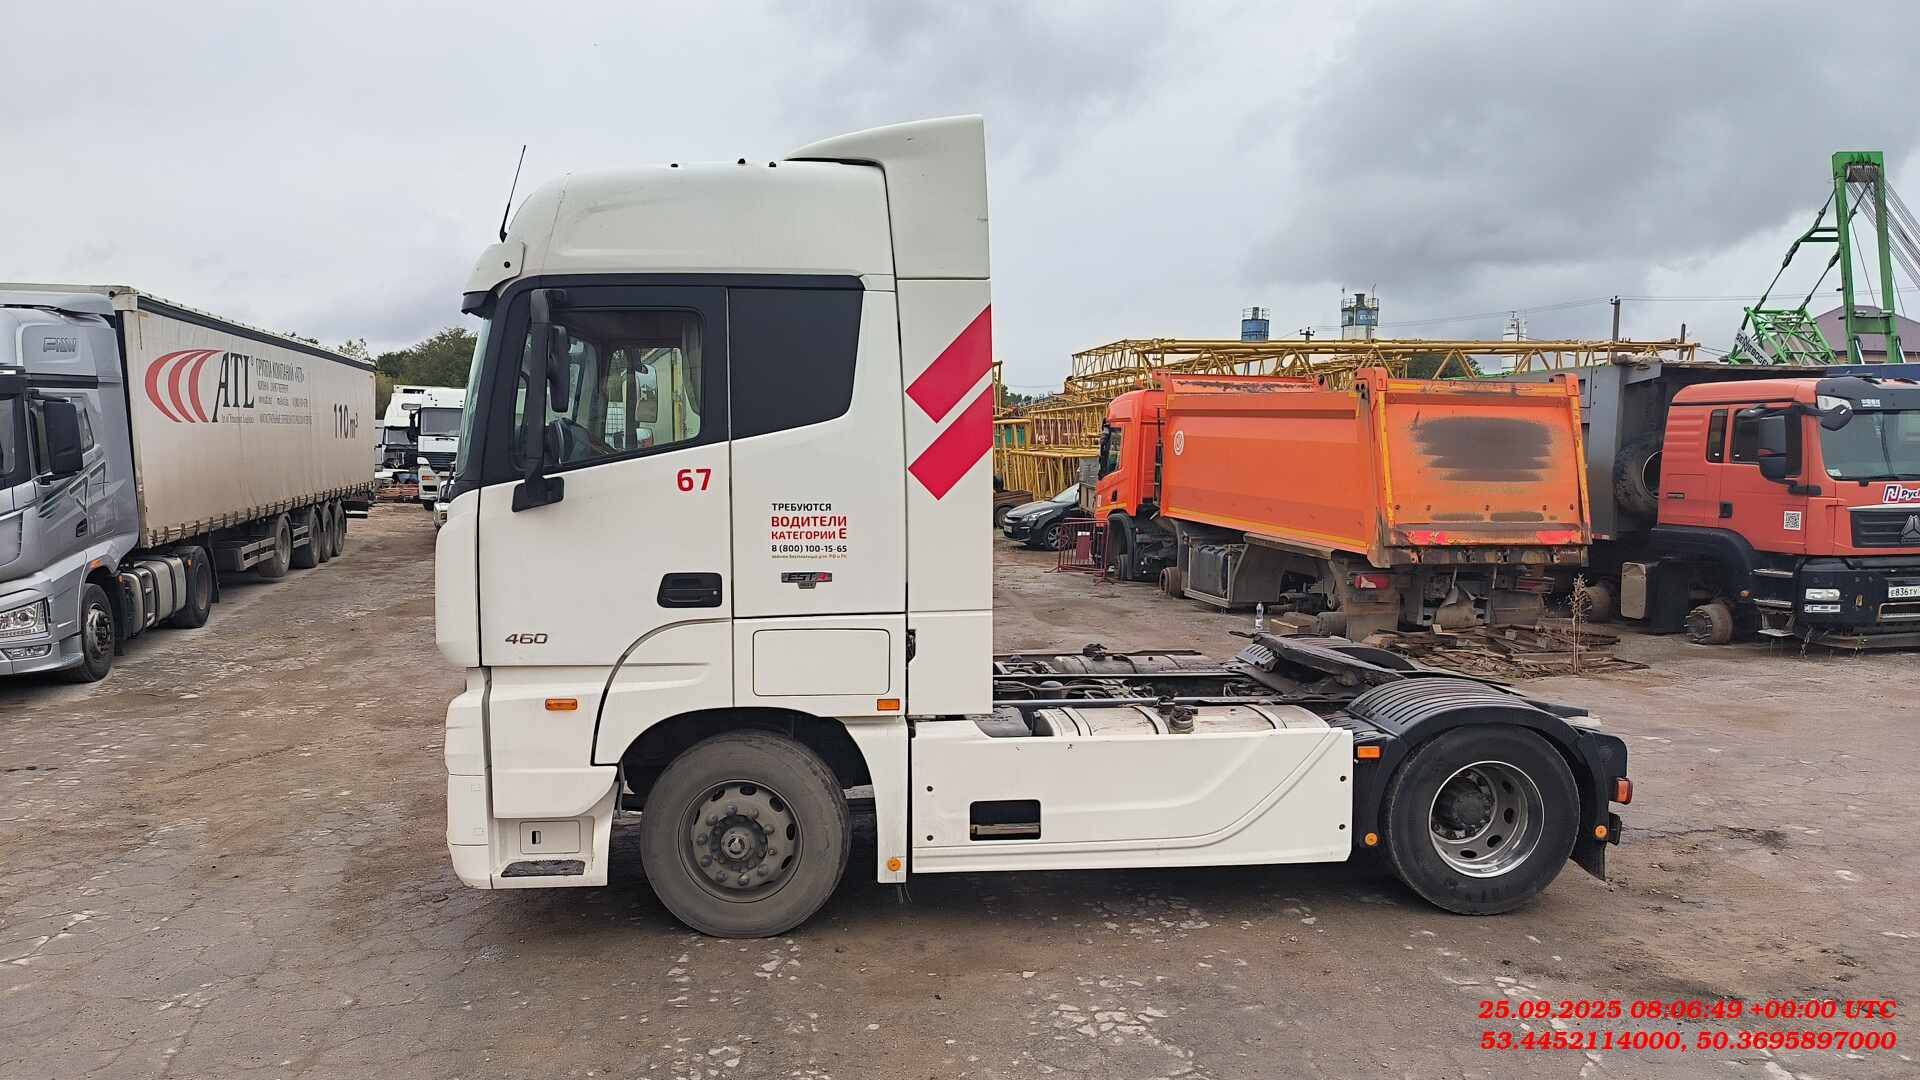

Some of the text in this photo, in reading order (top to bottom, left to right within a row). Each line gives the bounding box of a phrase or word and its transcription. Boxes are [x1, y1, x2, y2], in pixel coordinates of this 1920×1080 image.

[212, 352, 254, 422] ATL
[334, 403, 349, 439] 110
[677, 468, 711, 491] 67
[772, 503, 832, 511] ТРЕБУЮТСЯ
[771, 516, 847, 528] ВОДИТЕЛИ
[771, 530, 836, 540] КАТЕГОРИИ
[779, 545, 803, 553] (800)
[505, 634, 548, 644] 460
